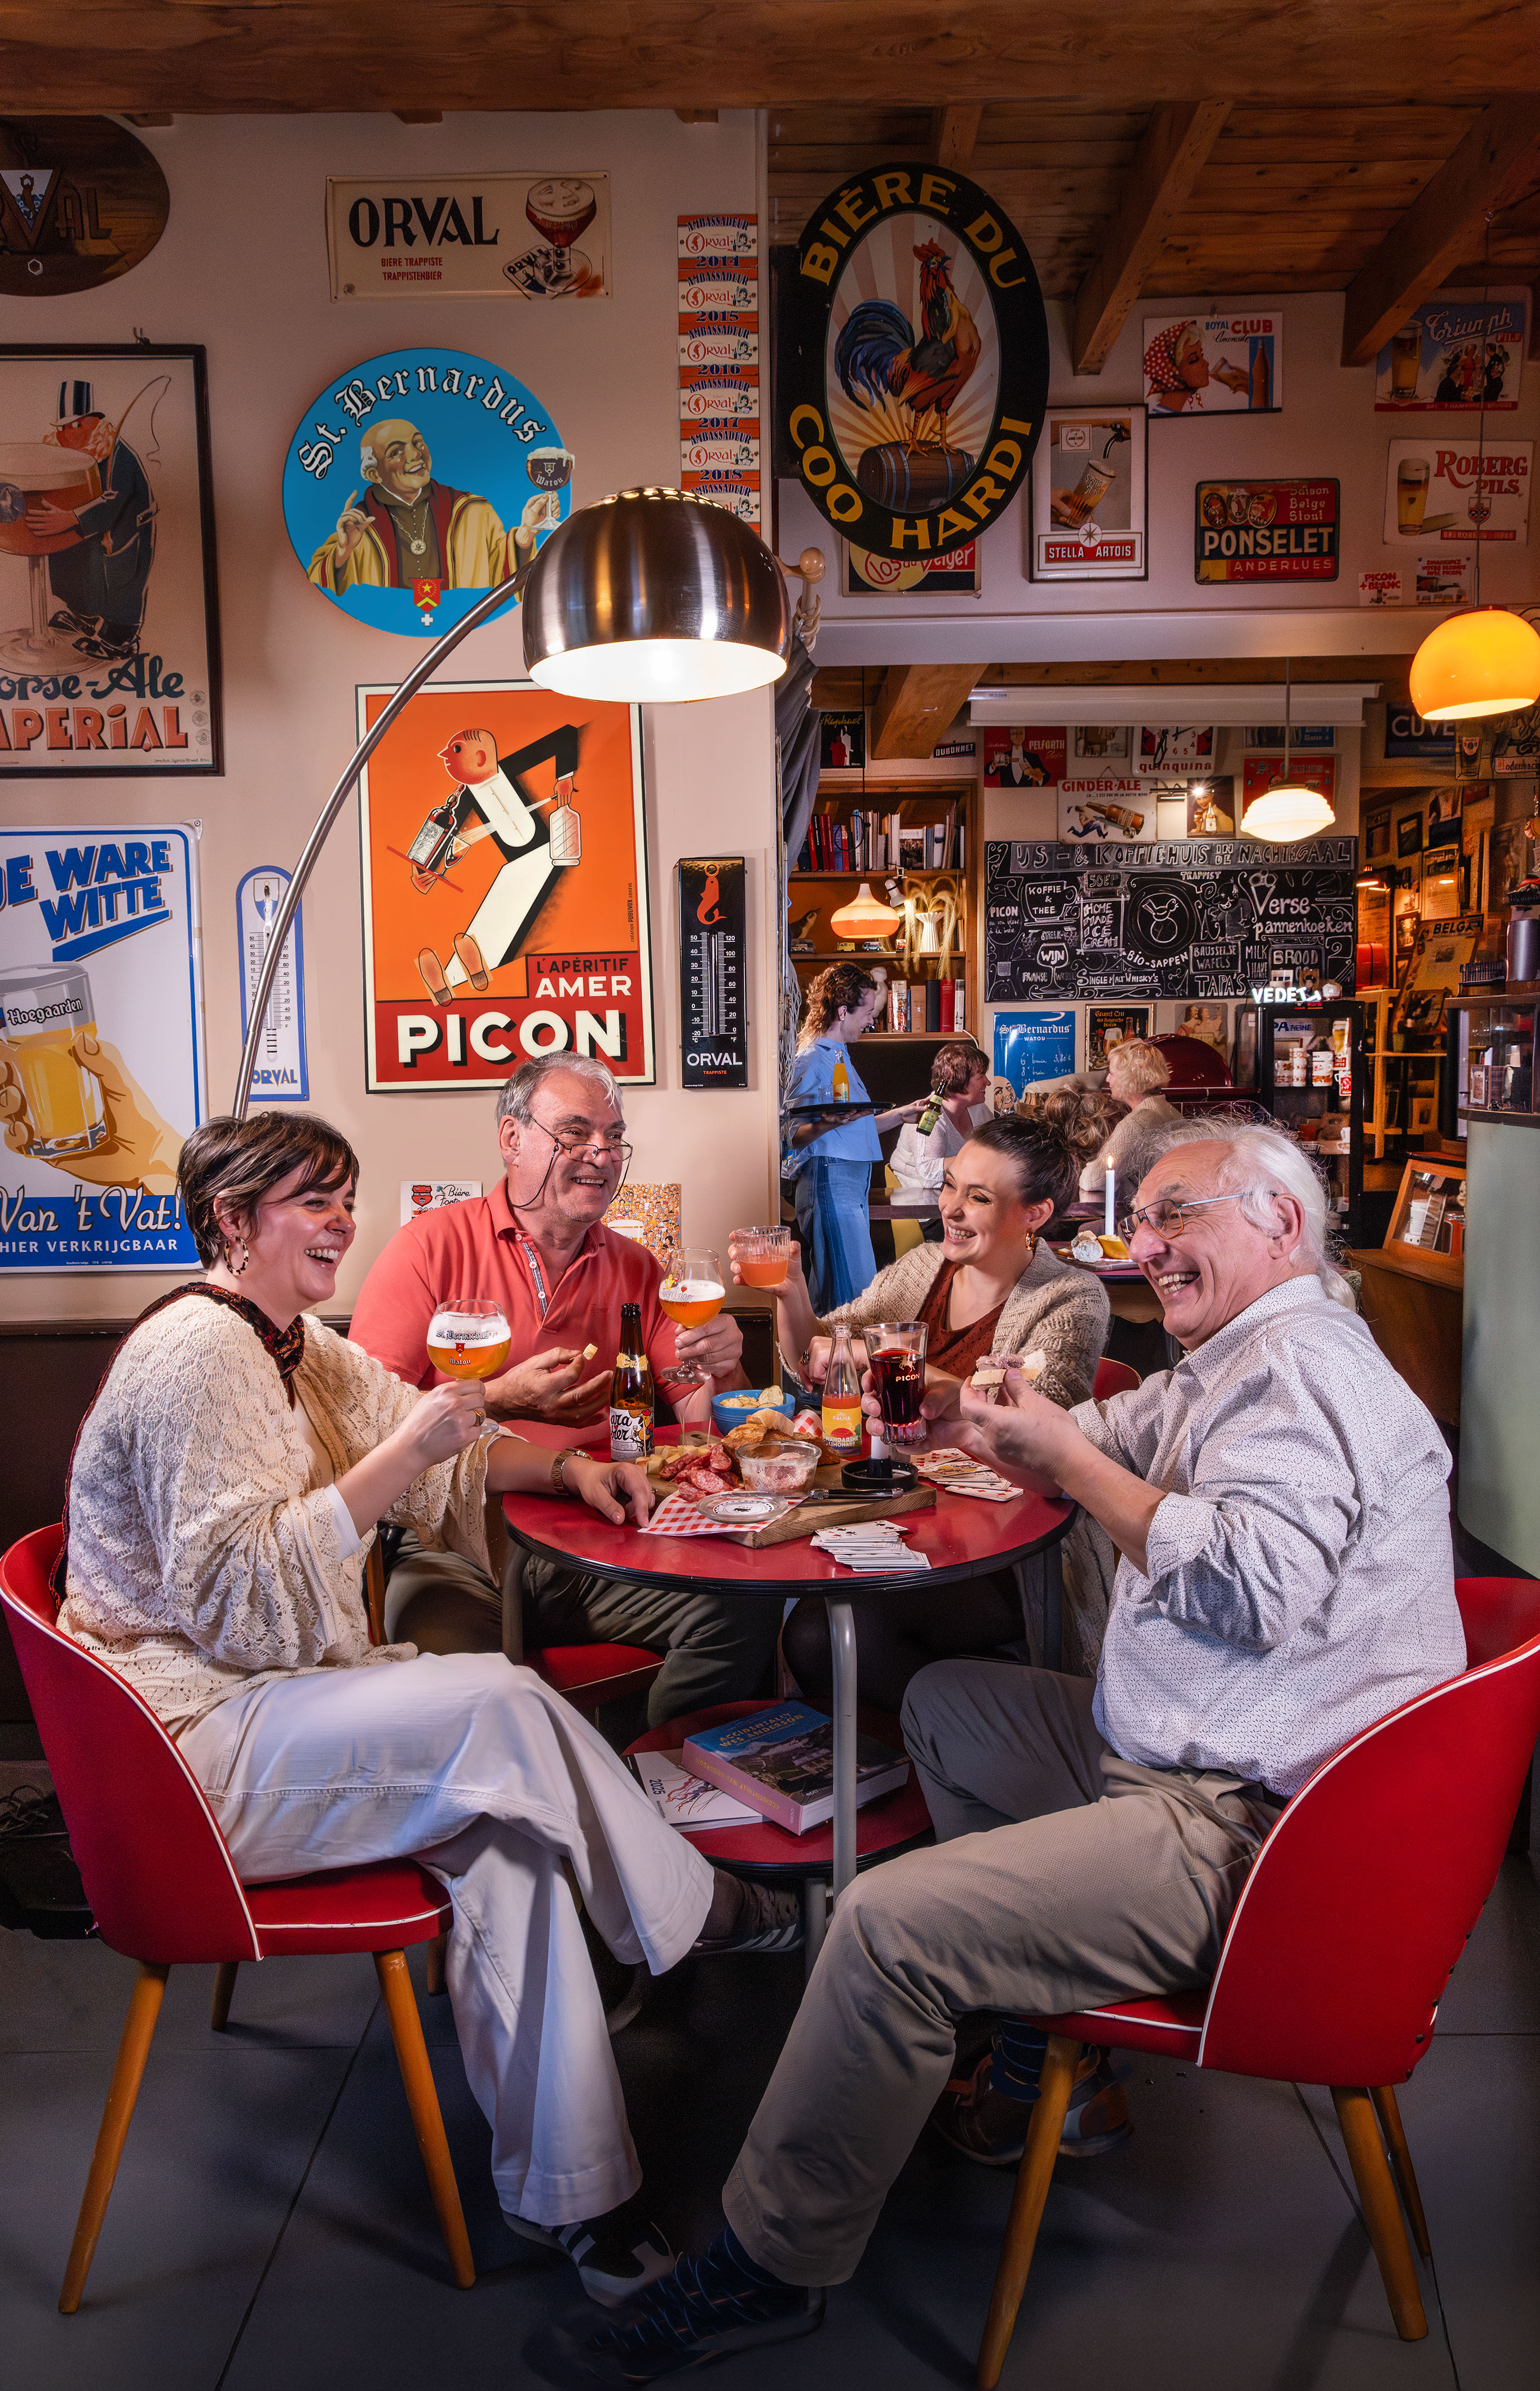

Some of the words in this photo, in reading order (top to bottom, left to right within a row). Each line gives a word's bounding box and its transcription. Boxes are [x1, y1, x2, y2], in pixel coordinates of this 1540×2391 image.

[348, 196, 500, 248] ORVAL
[686, 216, 750, 232] AMBASSADEUR
[963, 210, 1026, 289] DU
[404, 257, 443, 267] TRAPPISTE
[696, 256, 740, 268] 2014
[382, 271, 443, 281] TRAPPISTENBIER
[687, 271, 749, 287] AMBASSADEUR
[696, 310, 740, 323] 2015
[688, 325, 750, 340] AMBASSADEUR
[1230, 319, 1273, 334] CLUB
[697, 364, 741, 376] 2016
[689, 378, 751, 394] AMBASSADEUR
[298, 422, 347, 480] St.
[335, 366, 547, 443] Bernardus
[698, 417, 740, 429] 2017
[690, 430, 752, 446] AMBASSADEUR
[536, 473, 564, 487] Watou
[699, 469, 743, 481] 2018
[789, 404, 863, 523] COQ
[889, 416, 1032, 551] HARDI
[1473, 479, 1520, 495] PILS
[1290, 497, 1326, 509] Belge
[1204, 527, 1334, 557] PONSELET
[1049, 547, 1085, 558] STELLA
[1096, 545, 1132, 558] ARTOIS
[1234, 559, 1332, 571] ANDERLUES
[1364, 571, 1396, 582] PICON
[936, 743, 974, 757] DUBONNET
[1029, 739, 1065, 751] PELFORTH
[1061, 779, 1141, 792] GINDER-ALE
[1074, 844, 1089, 866] &
[1096, 844, 1210, 865] KOFFIEHUIS
[1237, 842, 1351, 864] NACHTEGAAL
[45, 840, 173, 891] WARE
[1180, 871, 1221, 880] TRAPPIST
[1029, 885, 1062, 895] KOFFIE
[39, 875, 165, 941] WITTE
[990, 906, 1018, 918] PICON
[1032, 906, 1057, 915] THEE
[1084, 902, 1113, 915] HOME
[1084, 914, 1114, 926] MADE
[1084, 926, 1111, 937] ICE
[1252, 916, 1353, 941] pannenkoeken
[1084, 936, 1119, 950] CREAM
[1040, 950, 1065, 965] WIJN
[1245, 944, 1269, 959] MILK
[1273, 950, 1318, 965] BROOD
[537, 958, 629, 974] L'APÉRITIF
[1127, 951, 1189, 968] BIO-SAPPEN
[1197, 958, 1230, 970] WAFELS
[1076, 968, 1107, 985] SINGLE
[1125, 973, 1159, 984] WHISKY'S
[535, 975, 632, 998] AMER
[1194, 974, 1246, 997] TAPA'S
[8, 997, 83, 1025] Hoegaarden
[1017, 1023, 1070, 1034] Bernardus
[398, 1010, 628, 1067] PICON
[686, 1052, 743, 1067] ORVAL
[251, 1065, 298, 1087] ORVAL
[443, 1185, 471, 1197] Bière
[0, 1185, 59, 1234] Van
[99, 1184, 182, 1234] Vat!
[47, 1239, 179, 1253] VERKRIJGBAAR
[446, 1329, 489, 1341] Bernardus
[449, 1357, 471, 1366] Watou
[895, 1372, 920, 1382] PICON
[719, 1712, 792, 1742] ACCIDENTALLY
[719, 1737, 745, 1747] WES
[747, 1714, 805, 1738] ANDERSON
[649, 1778, 666, 1795] 2025
